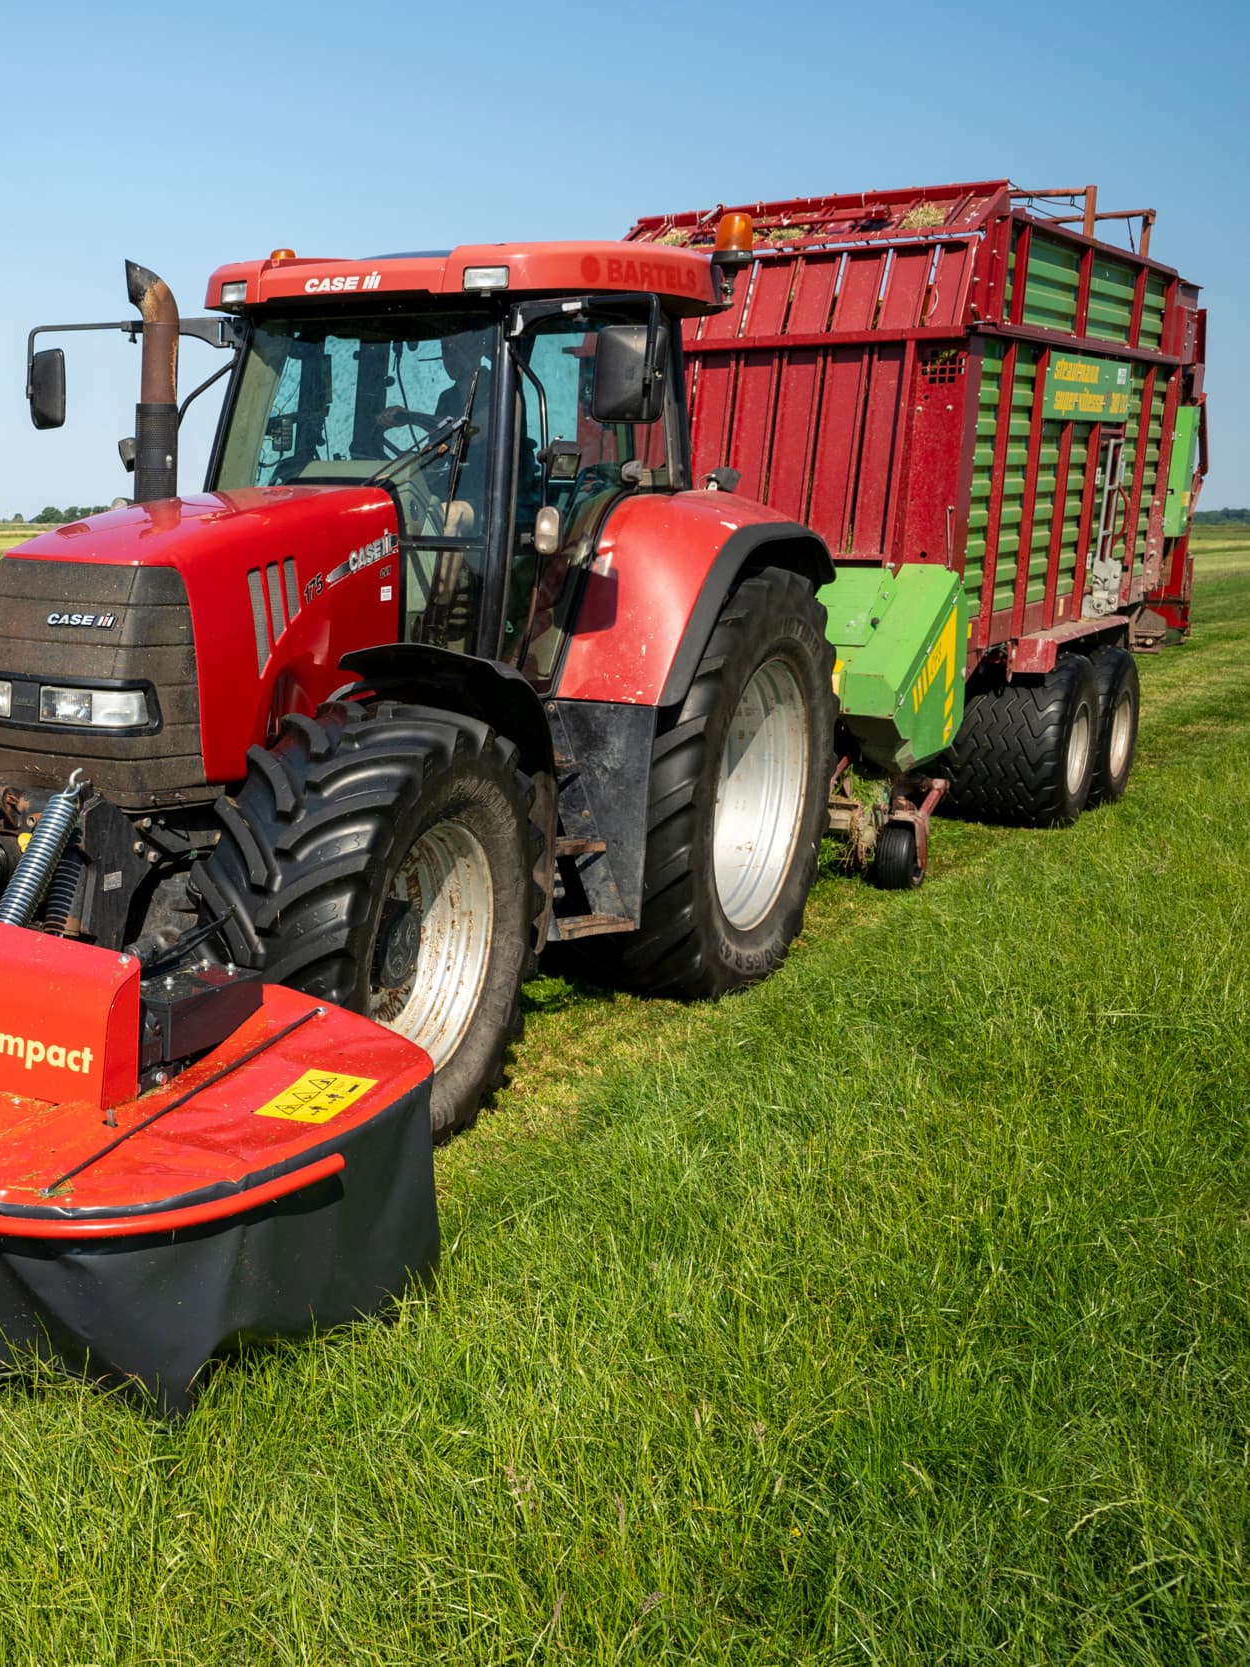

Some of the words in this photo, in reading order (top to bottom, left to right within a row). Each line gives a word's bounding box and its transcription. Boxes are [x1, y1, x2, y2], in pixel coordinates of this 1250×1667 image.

[304, 276, 360, 293] CASE
[607, 258, 697, 292] BARTELS
[349, 537, 383, 572] CASE
[304, 571, 324, 605] 175
[47, 613, 95, 626] CASE
